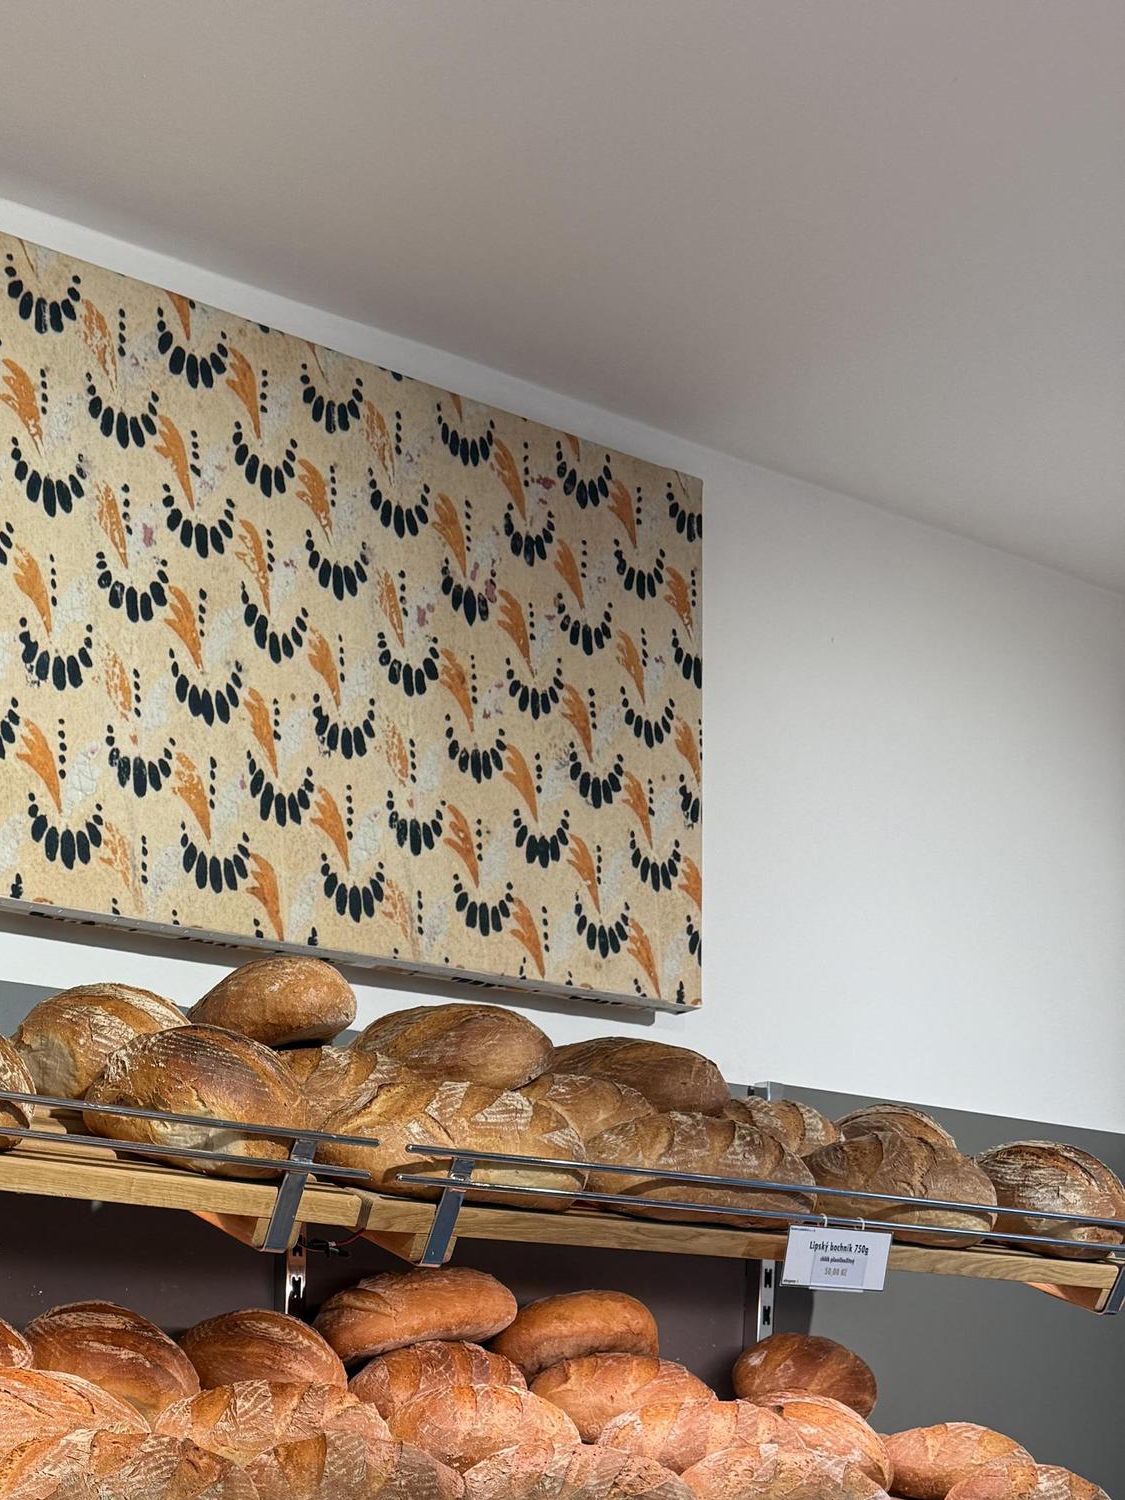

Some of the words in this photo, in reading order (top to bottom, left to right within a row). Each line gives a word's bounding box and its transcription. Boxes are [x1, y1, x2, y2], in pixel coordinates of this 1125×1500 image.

[810, 1241, 828, 1252] Lipský
[830, 1242, 852, 1253] bochník
[854, 1245, 869, 1255] 750g
